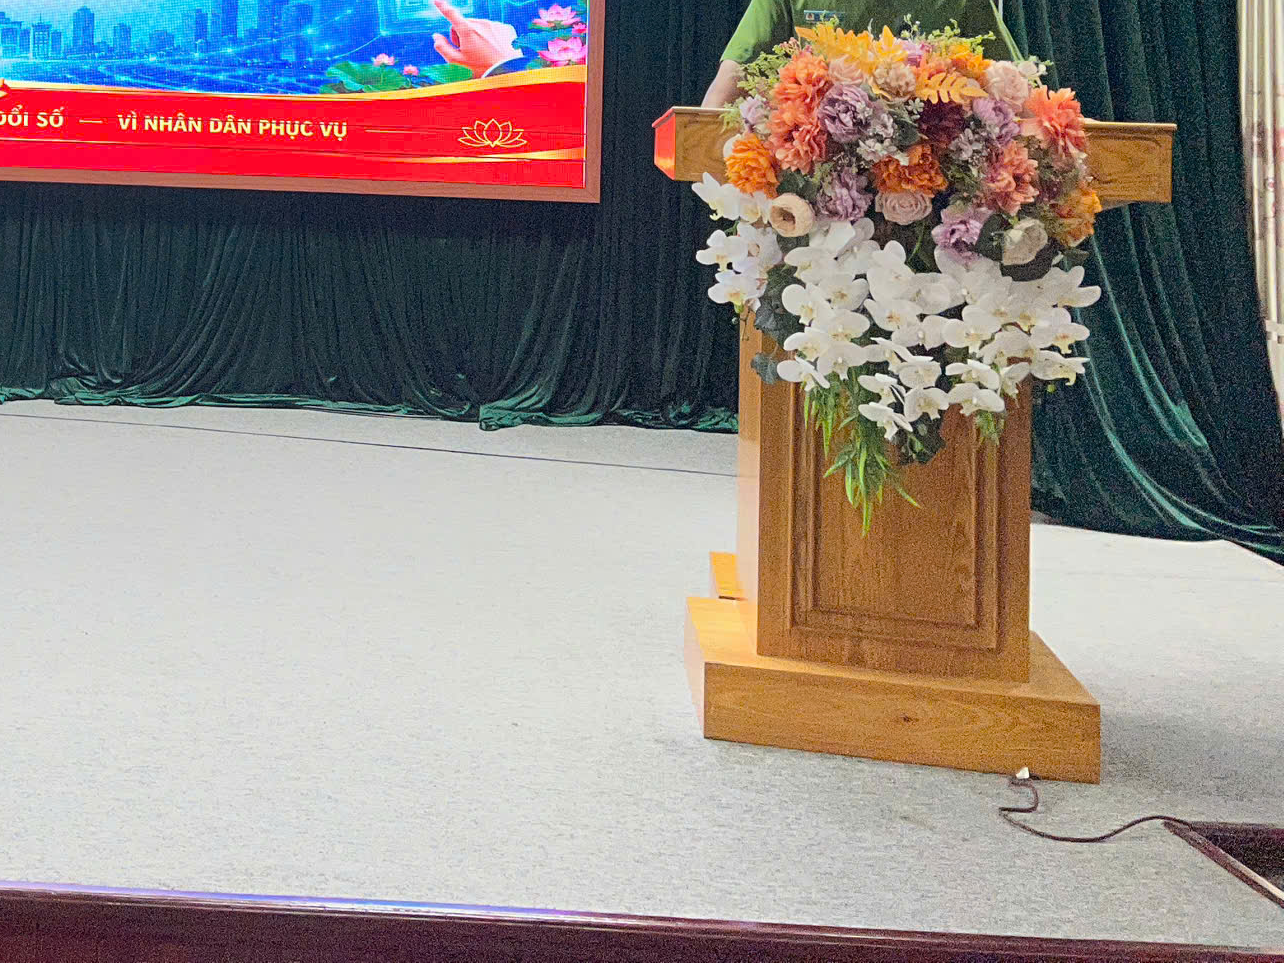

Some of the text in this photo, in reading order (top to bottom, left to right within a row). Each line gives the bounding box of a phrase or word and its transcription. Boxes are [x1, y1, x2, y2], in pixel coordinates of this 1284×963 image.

[36, 106, 65, 128] SỐ
[117, 110, 348, 141] VÌ NHÂN DÂN PHỤC VỤ
